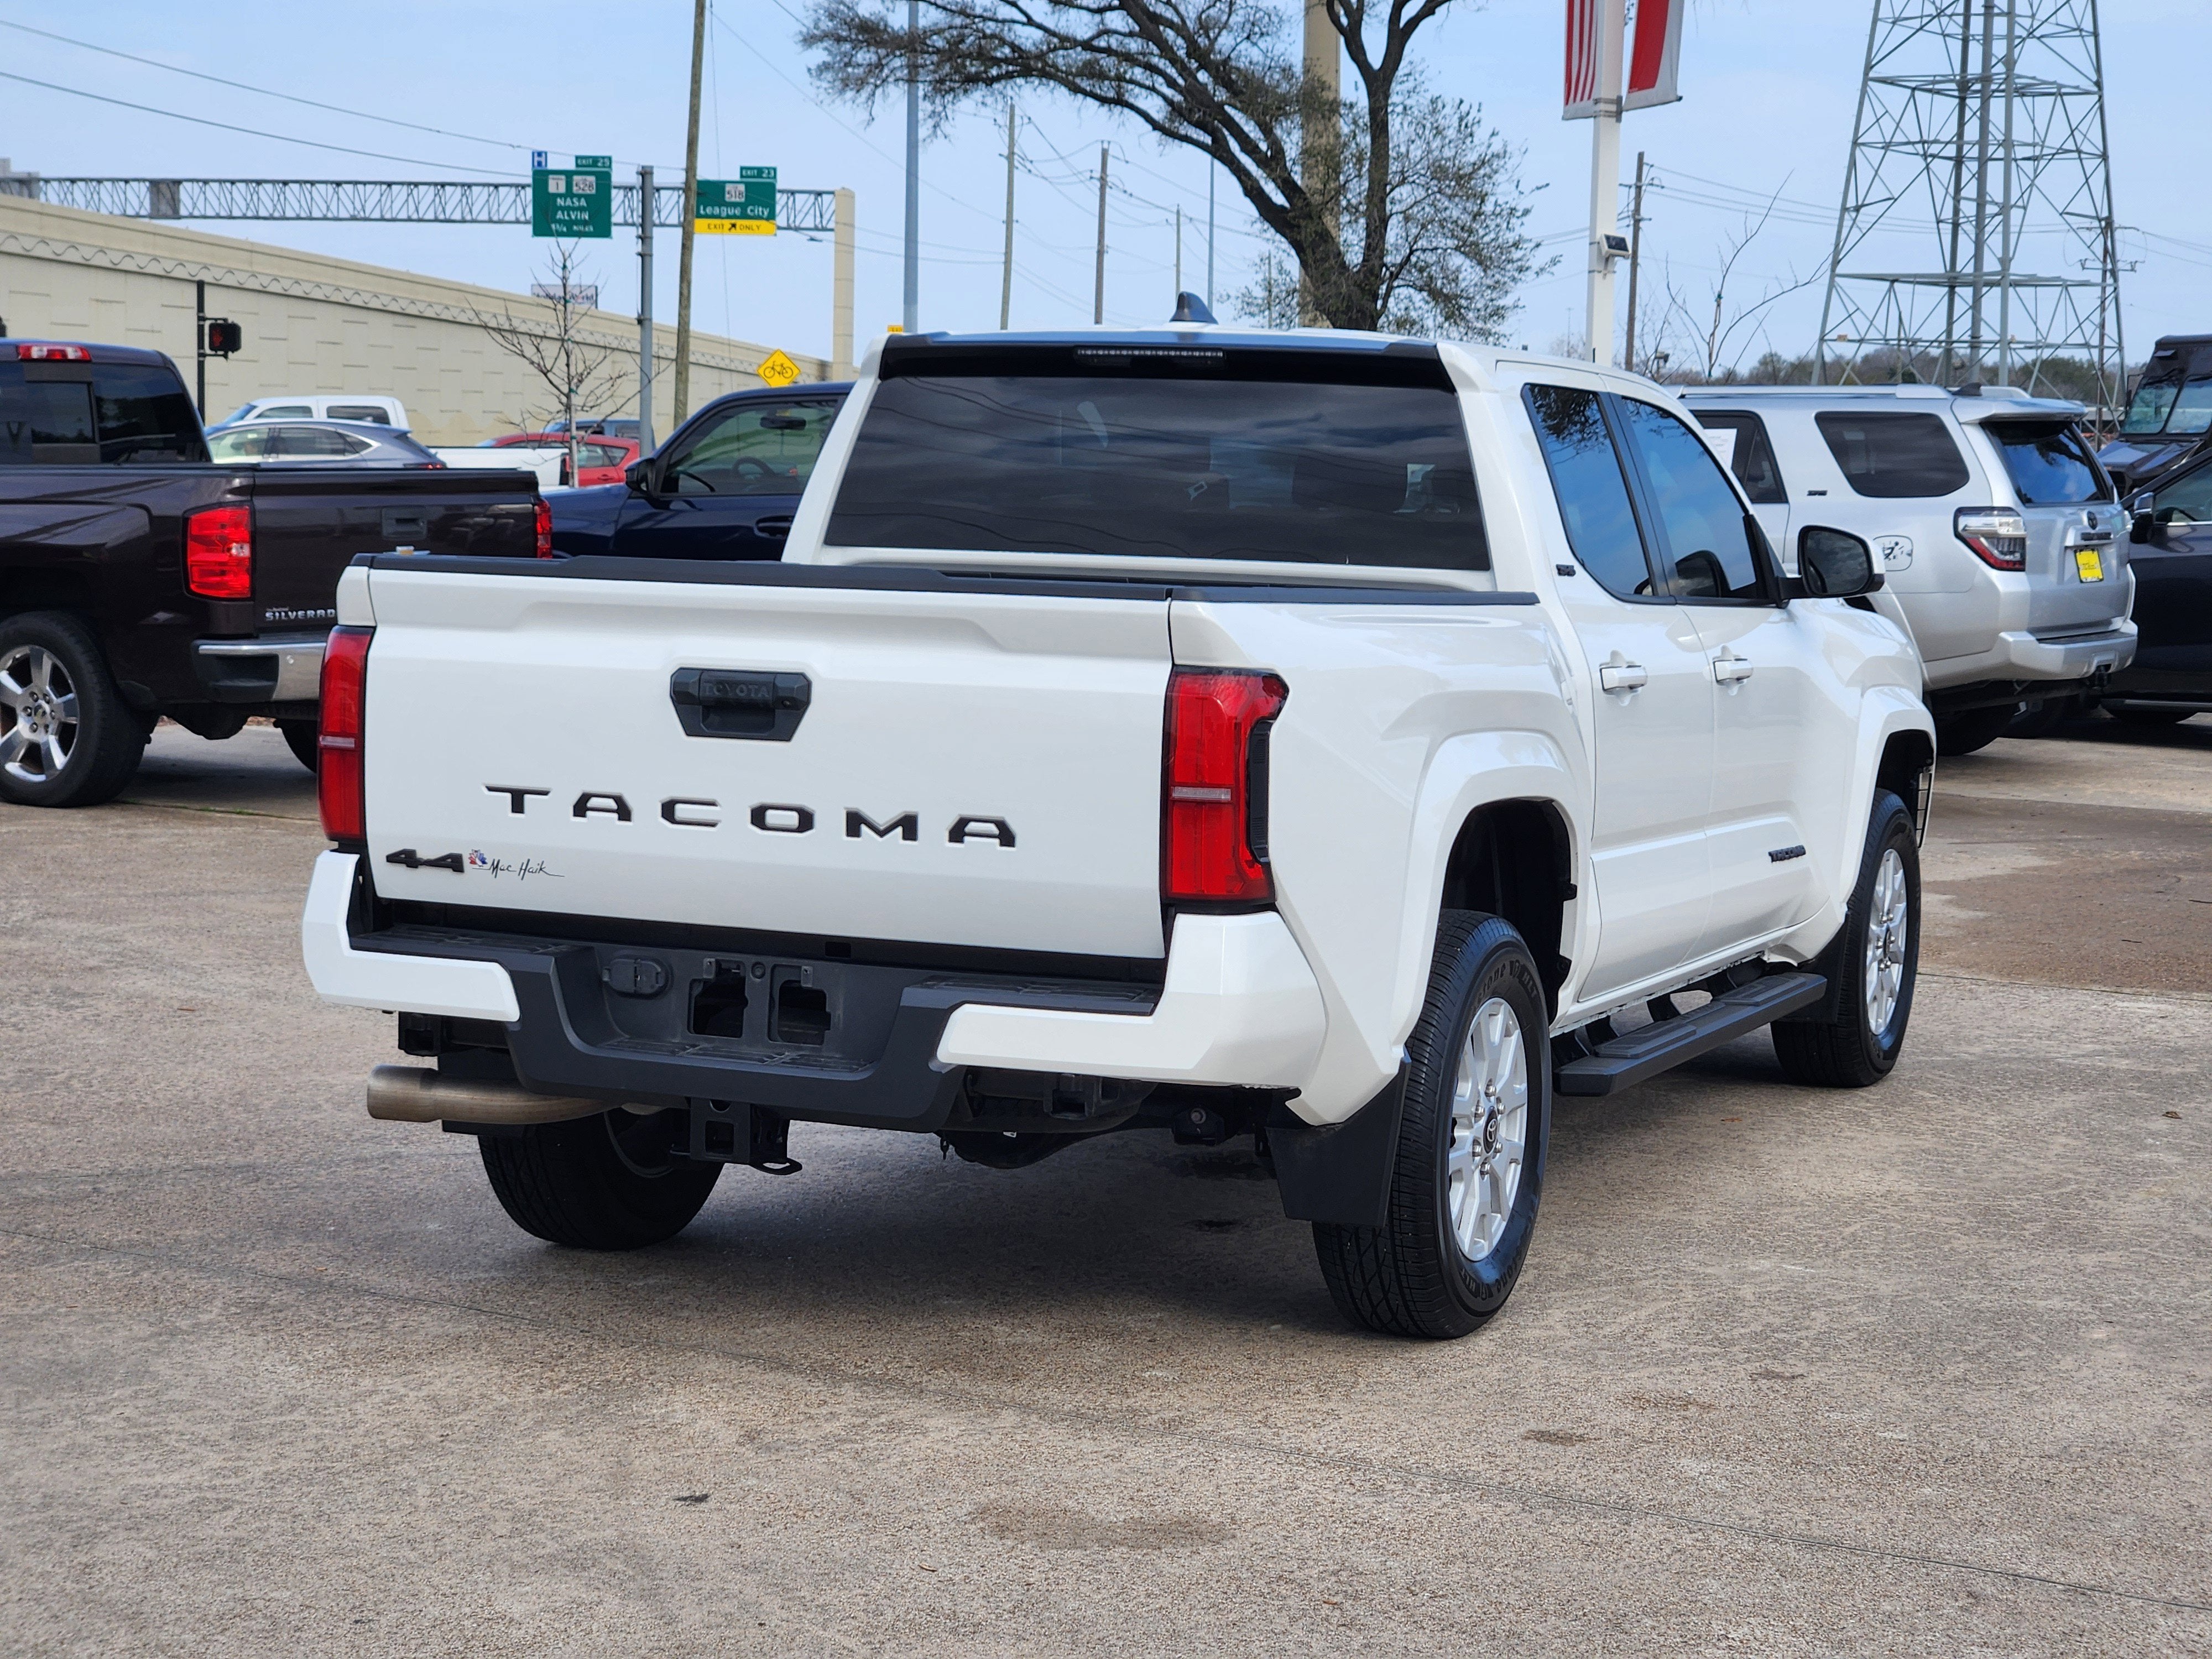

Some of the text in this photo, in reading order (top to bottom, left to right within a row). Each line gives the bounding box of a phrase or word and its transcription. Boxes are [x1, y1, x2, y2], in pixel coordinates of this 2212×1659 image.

[761, 168, 774, 178] 23
[575, 181, 594, 191] 528
[727, 190, 744, 200] 518
[556, 197, 587, 207] NASA
[556, 210, 589, 220] ALVIN
[700, 205, 769, 218] League City
[265, 608, 336, 620] SILVERAD
[703, 682, 770, 697] TOYOTA
[484, 785, 1017, 848] TACOMA
[488, 858, 555, 880] Mac Haik
